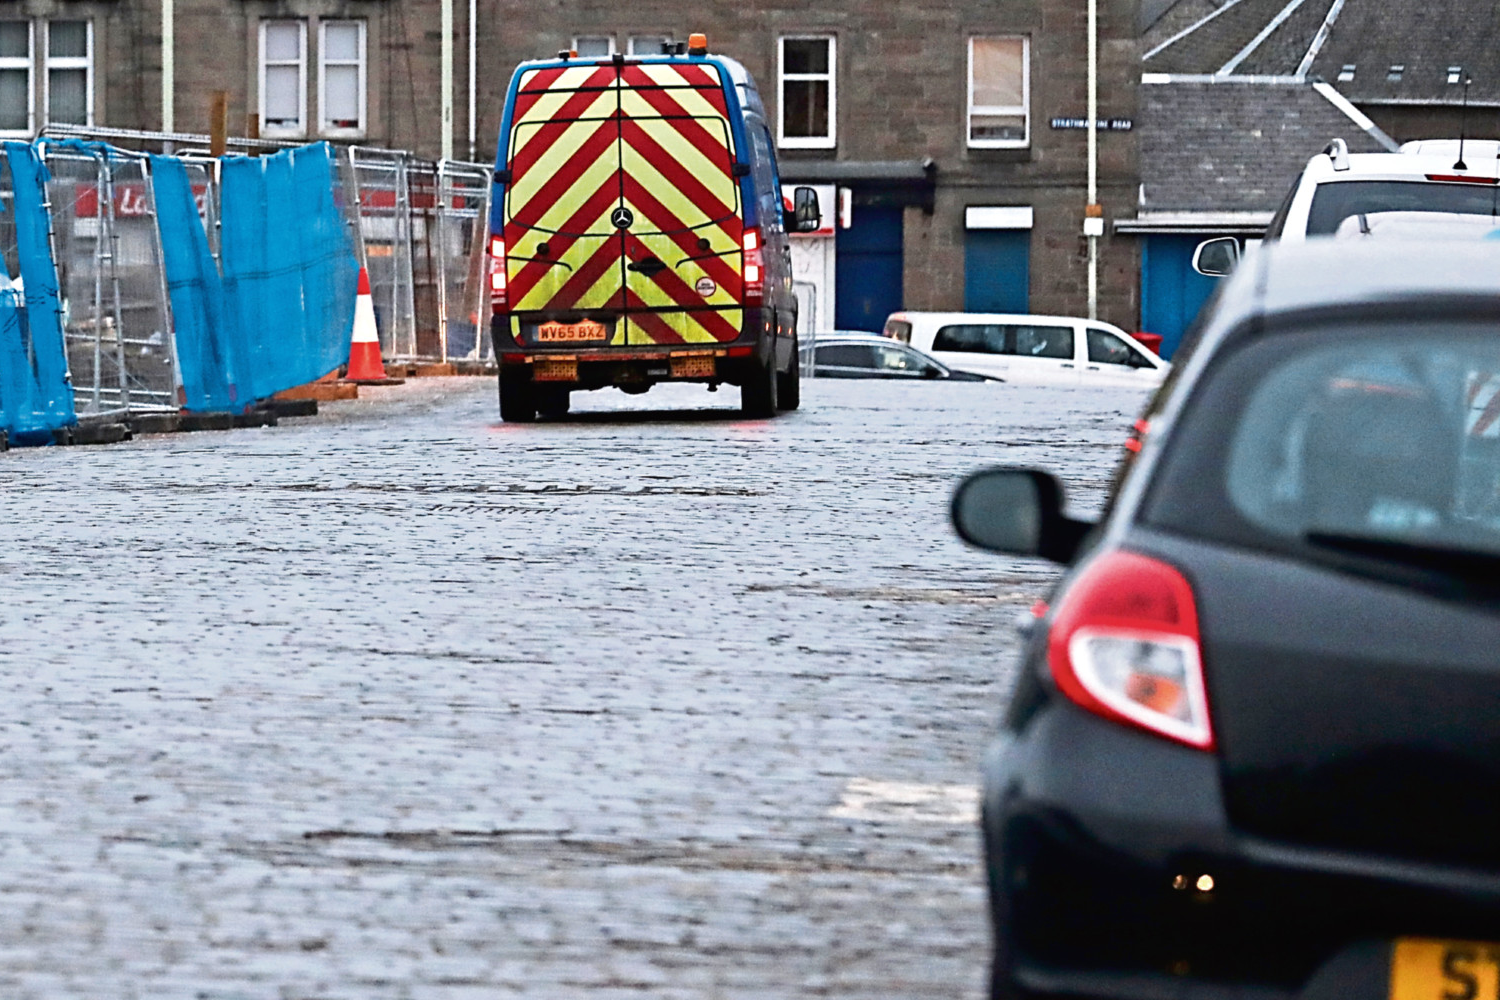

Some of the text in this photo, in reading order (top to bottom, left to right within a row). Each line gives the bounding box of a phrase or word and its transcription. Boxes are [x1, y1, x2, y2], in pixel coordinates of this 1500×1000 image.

[1052, 119, 1132, 130] STRATHMAINE ROAD
[540, 325, 604, 339] WV65 BXZ
